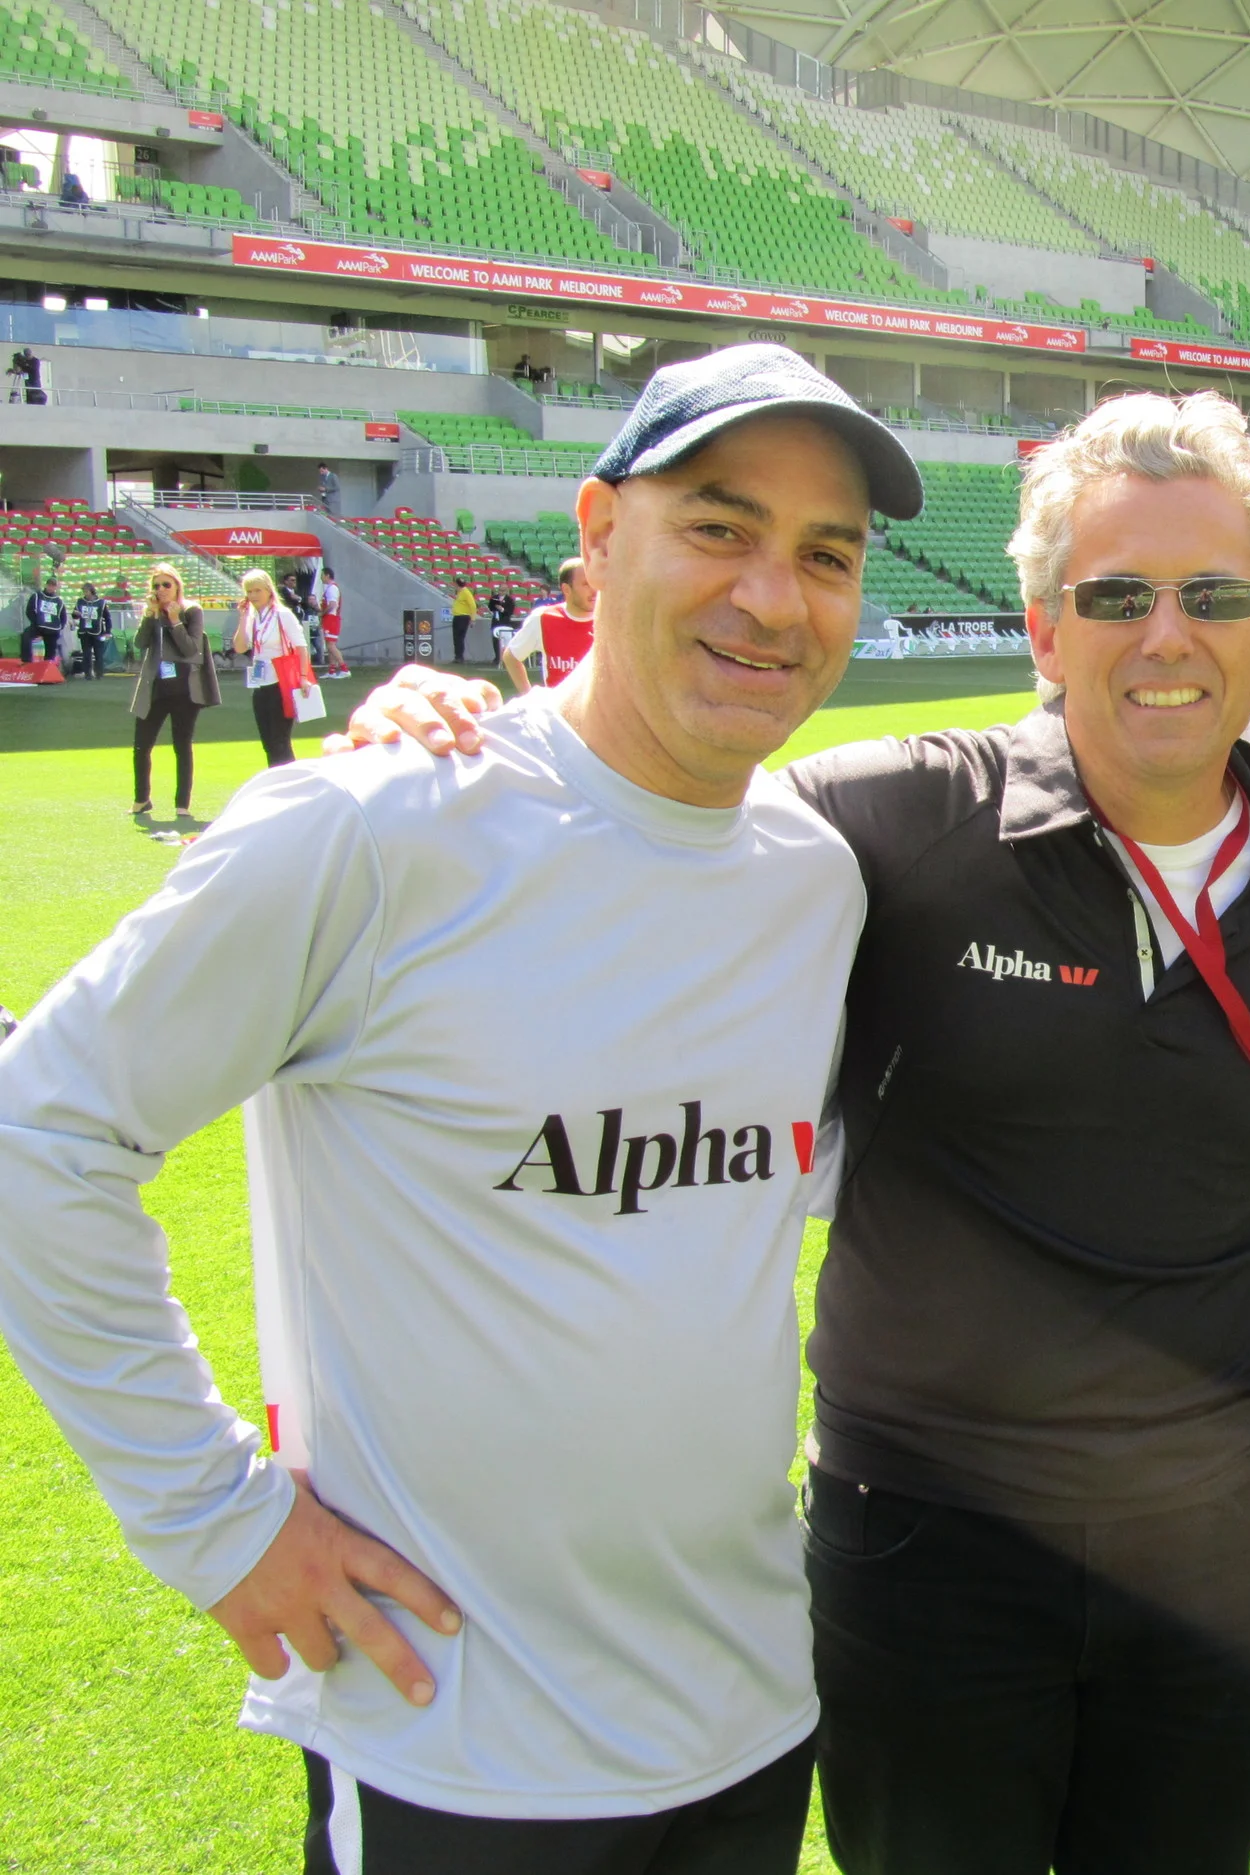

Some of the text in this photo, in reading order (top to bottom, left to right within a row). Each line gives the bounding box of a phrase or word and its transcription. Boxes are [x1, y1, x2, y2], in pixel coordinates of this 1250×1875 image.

[411, 264, 623, 298] WELCOME TO AAMI PARK MELBOURNE
[824, 309, 983, 338] WELCOME TO AAMI PARK MELBOURNE
[1178, 349, 1212, 364] WELCOME
[1213, 354, 1223, 365] TO
[1223, 355, 1240, 367] AAMI
[229, 531, 263, 545] AAMI
[941, 621, 994, 632] LA TROBE
[957, 941, 1052, 981] Alpha
[492, 1100, 775, 1216] Alpha
